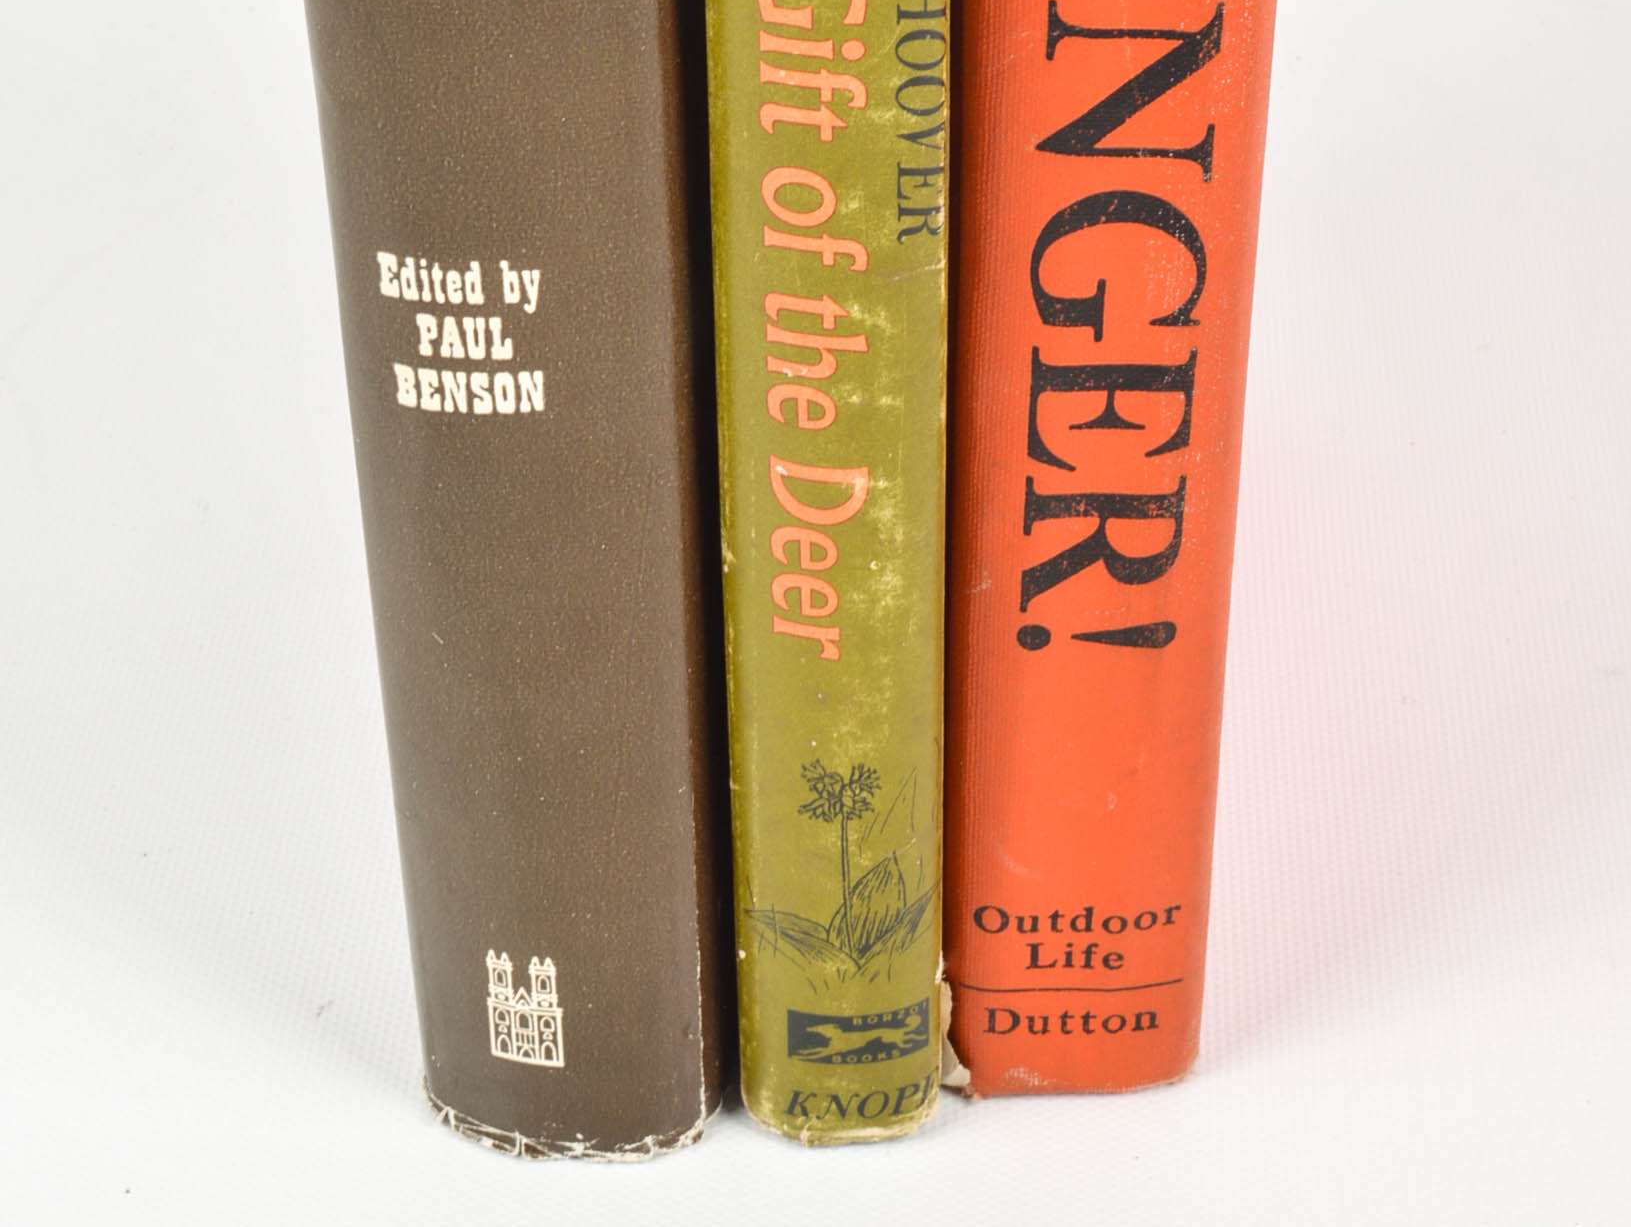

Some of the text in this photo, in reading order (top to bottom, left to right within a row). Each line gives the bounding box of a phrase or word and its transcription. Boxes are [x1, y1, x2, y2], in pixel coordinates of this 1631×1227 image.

[761, 165, 870, 272] of
[376, 250, 541, 314] Edited by
[416, 313, 513, 360] PAUL
[764, 290, 869, 431] the
[393, 362, 545, 415] BENSON
[769, 454, 870, 662] Deer
[973, 904, 1182, 934] Outdoor
[1025, 942, 1125, 970] Life
[852, 1001, 927, 1026] BORZOI
[983, 1006, 1159, 1035] Dutton
[832, 1048, 901, 1064] BOOKS
